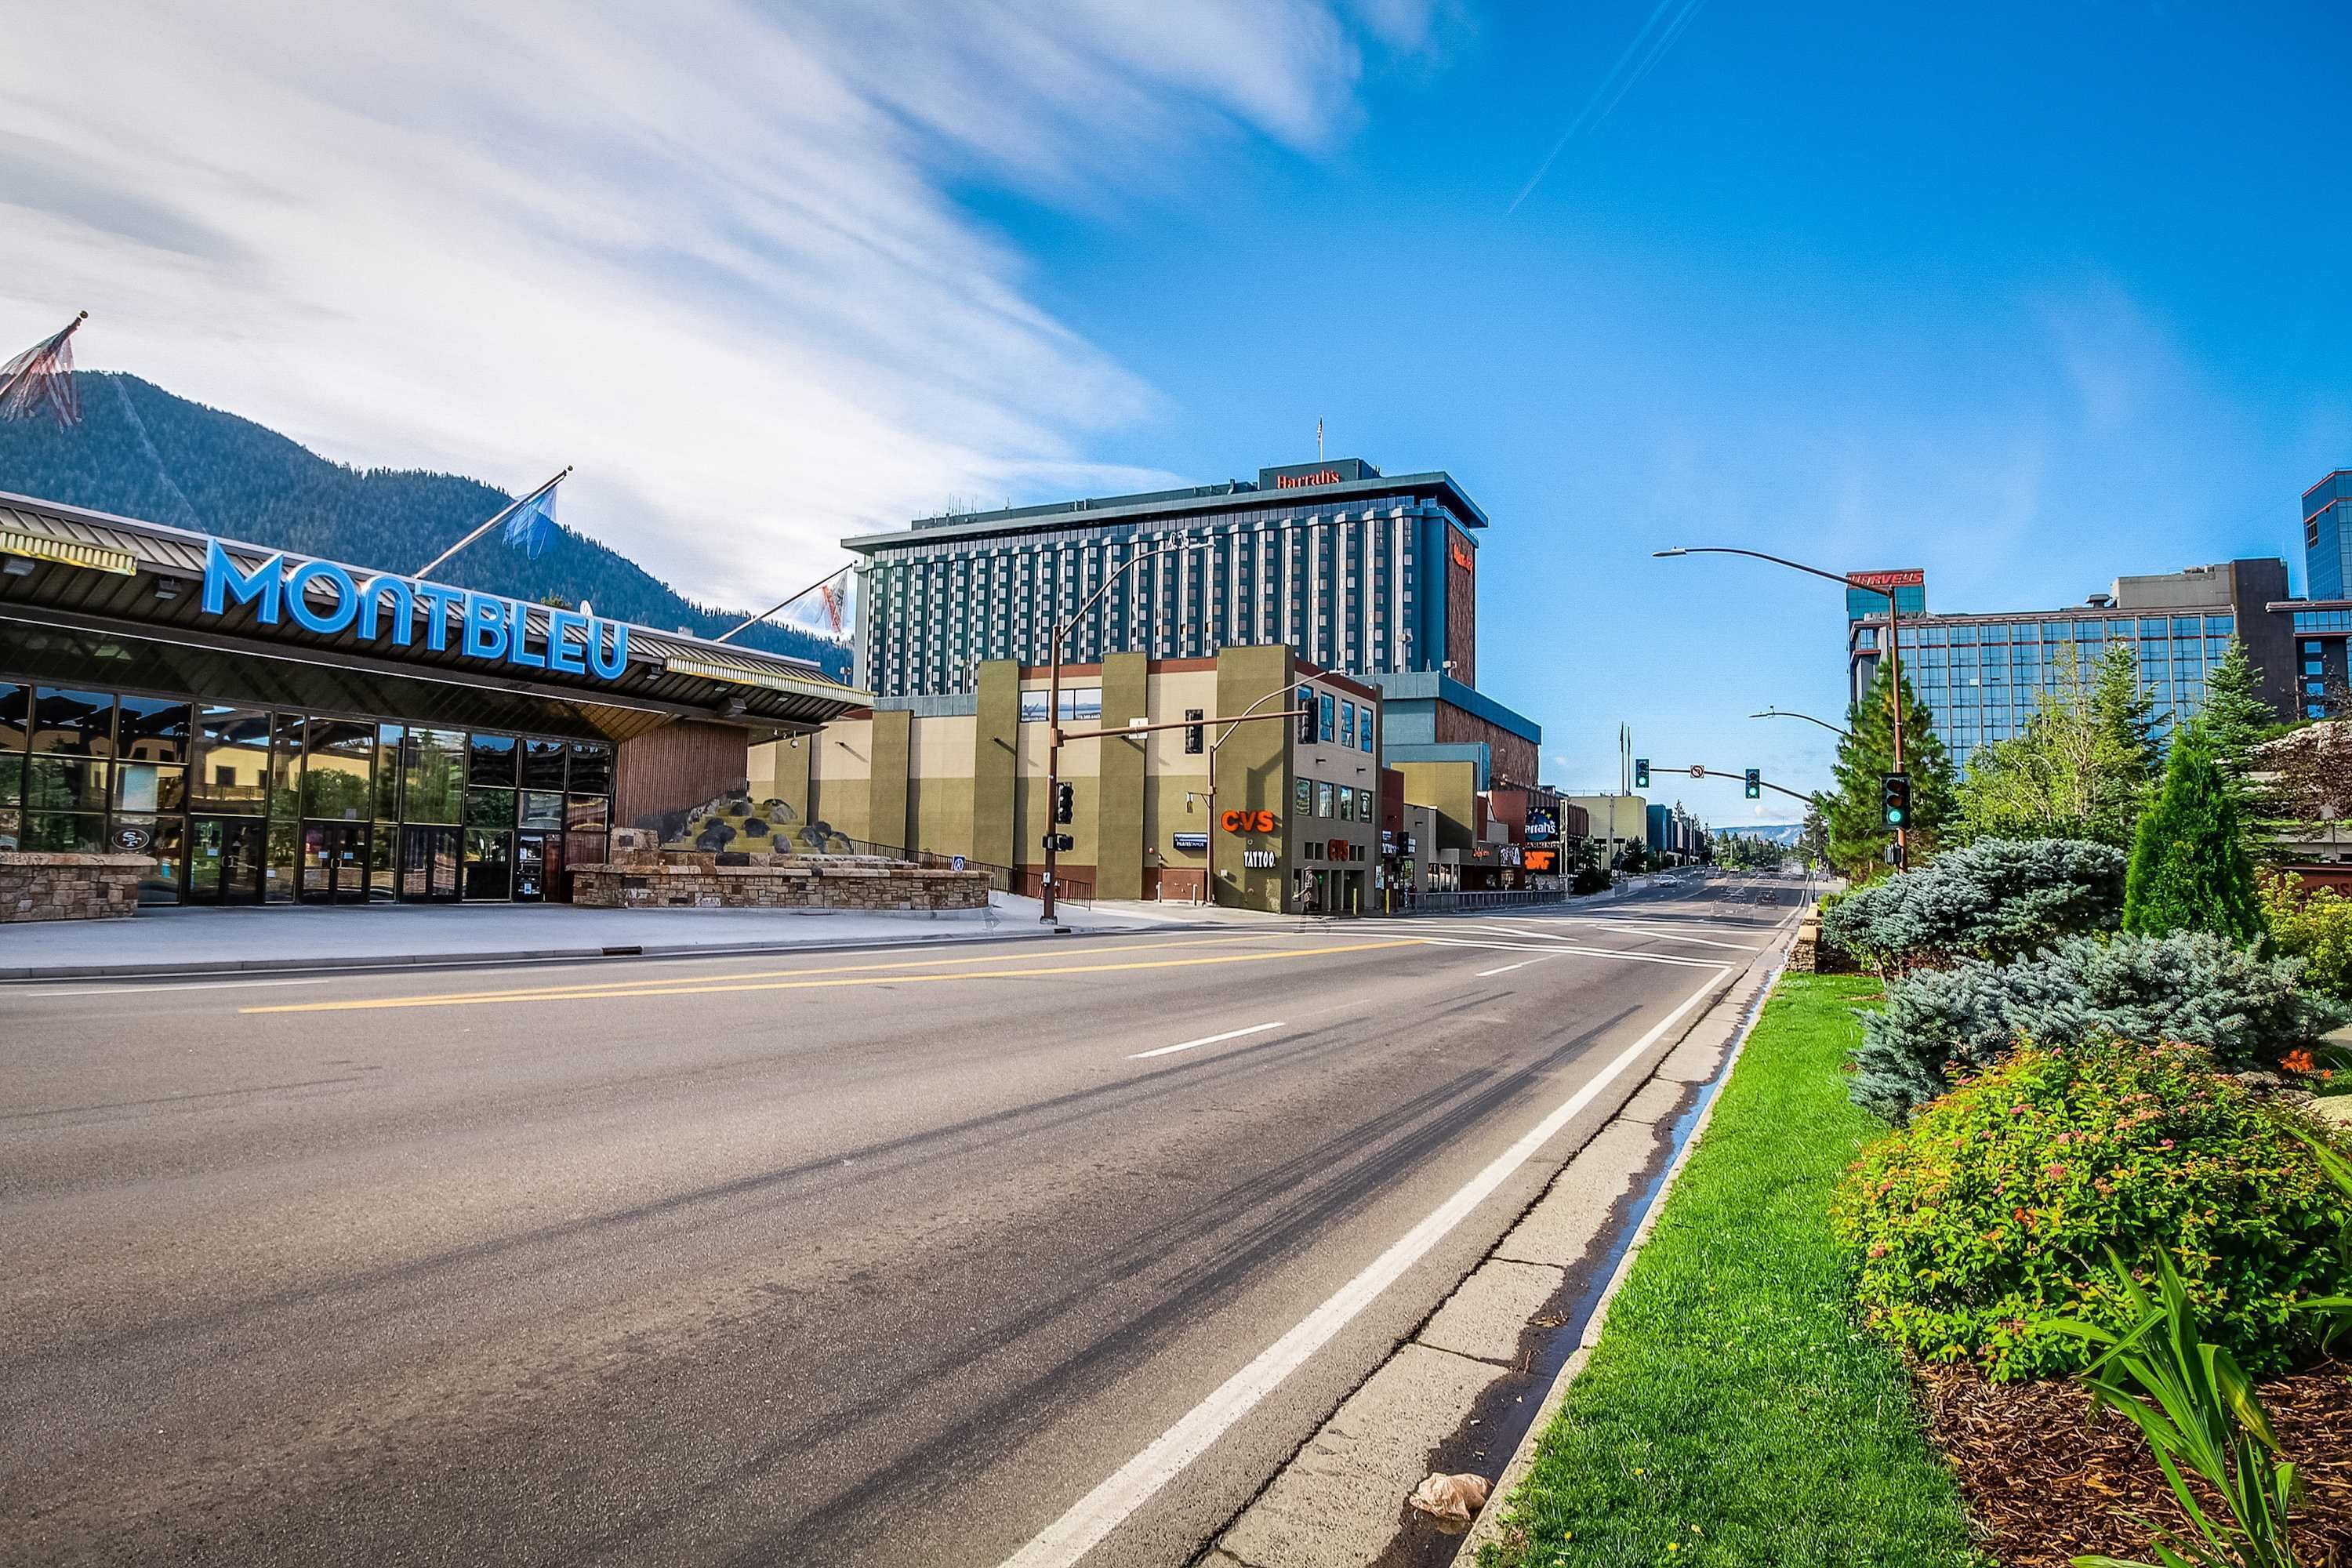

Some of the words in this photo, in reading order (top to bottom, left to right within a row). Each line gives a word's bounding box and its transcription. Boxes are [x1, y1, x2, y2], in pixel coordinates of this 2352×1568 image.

[1276, 469, 1339, 489] Harrah's
[201, 538, 628, 681] MONTBLEU
[1221, 809, 1274, 833] CVS
[1525, 819, 1556, 834] arrah's
[1328, 840, 1348, 861] CVS
